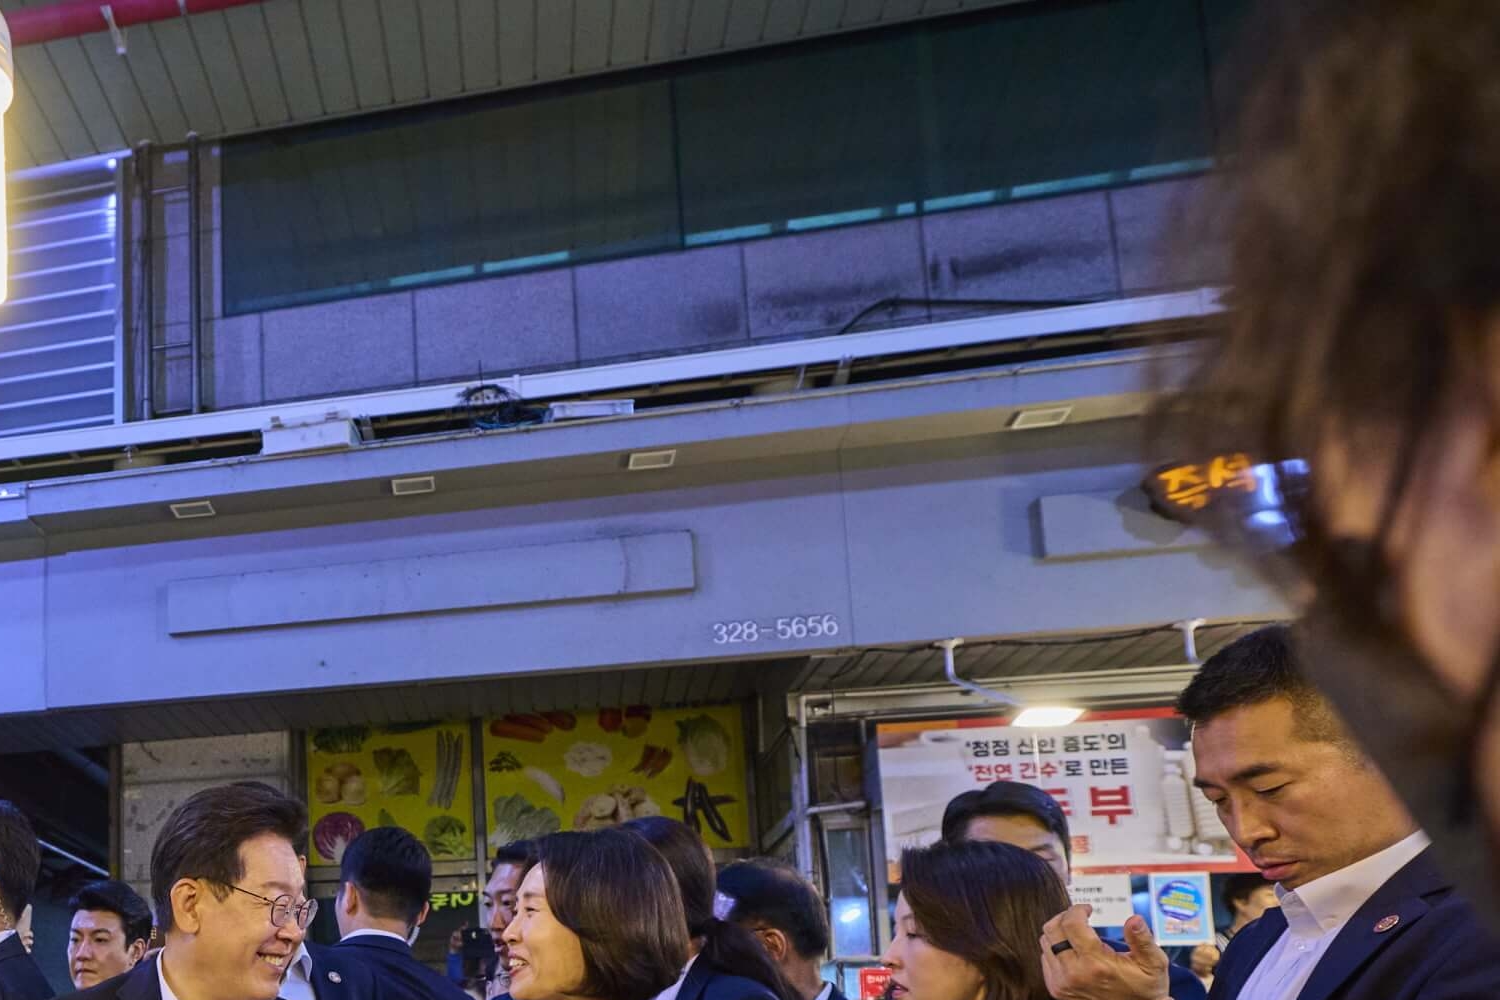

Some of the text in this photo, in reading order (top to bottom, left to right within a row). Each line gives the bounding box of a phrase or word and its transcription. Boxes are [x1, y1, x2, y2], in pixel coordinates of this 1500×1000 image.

[713, 614, 839, 644] 328-5656
[1018, 737, 1056, 756] 신안
[1090, 758, 1130, 776] 만든
